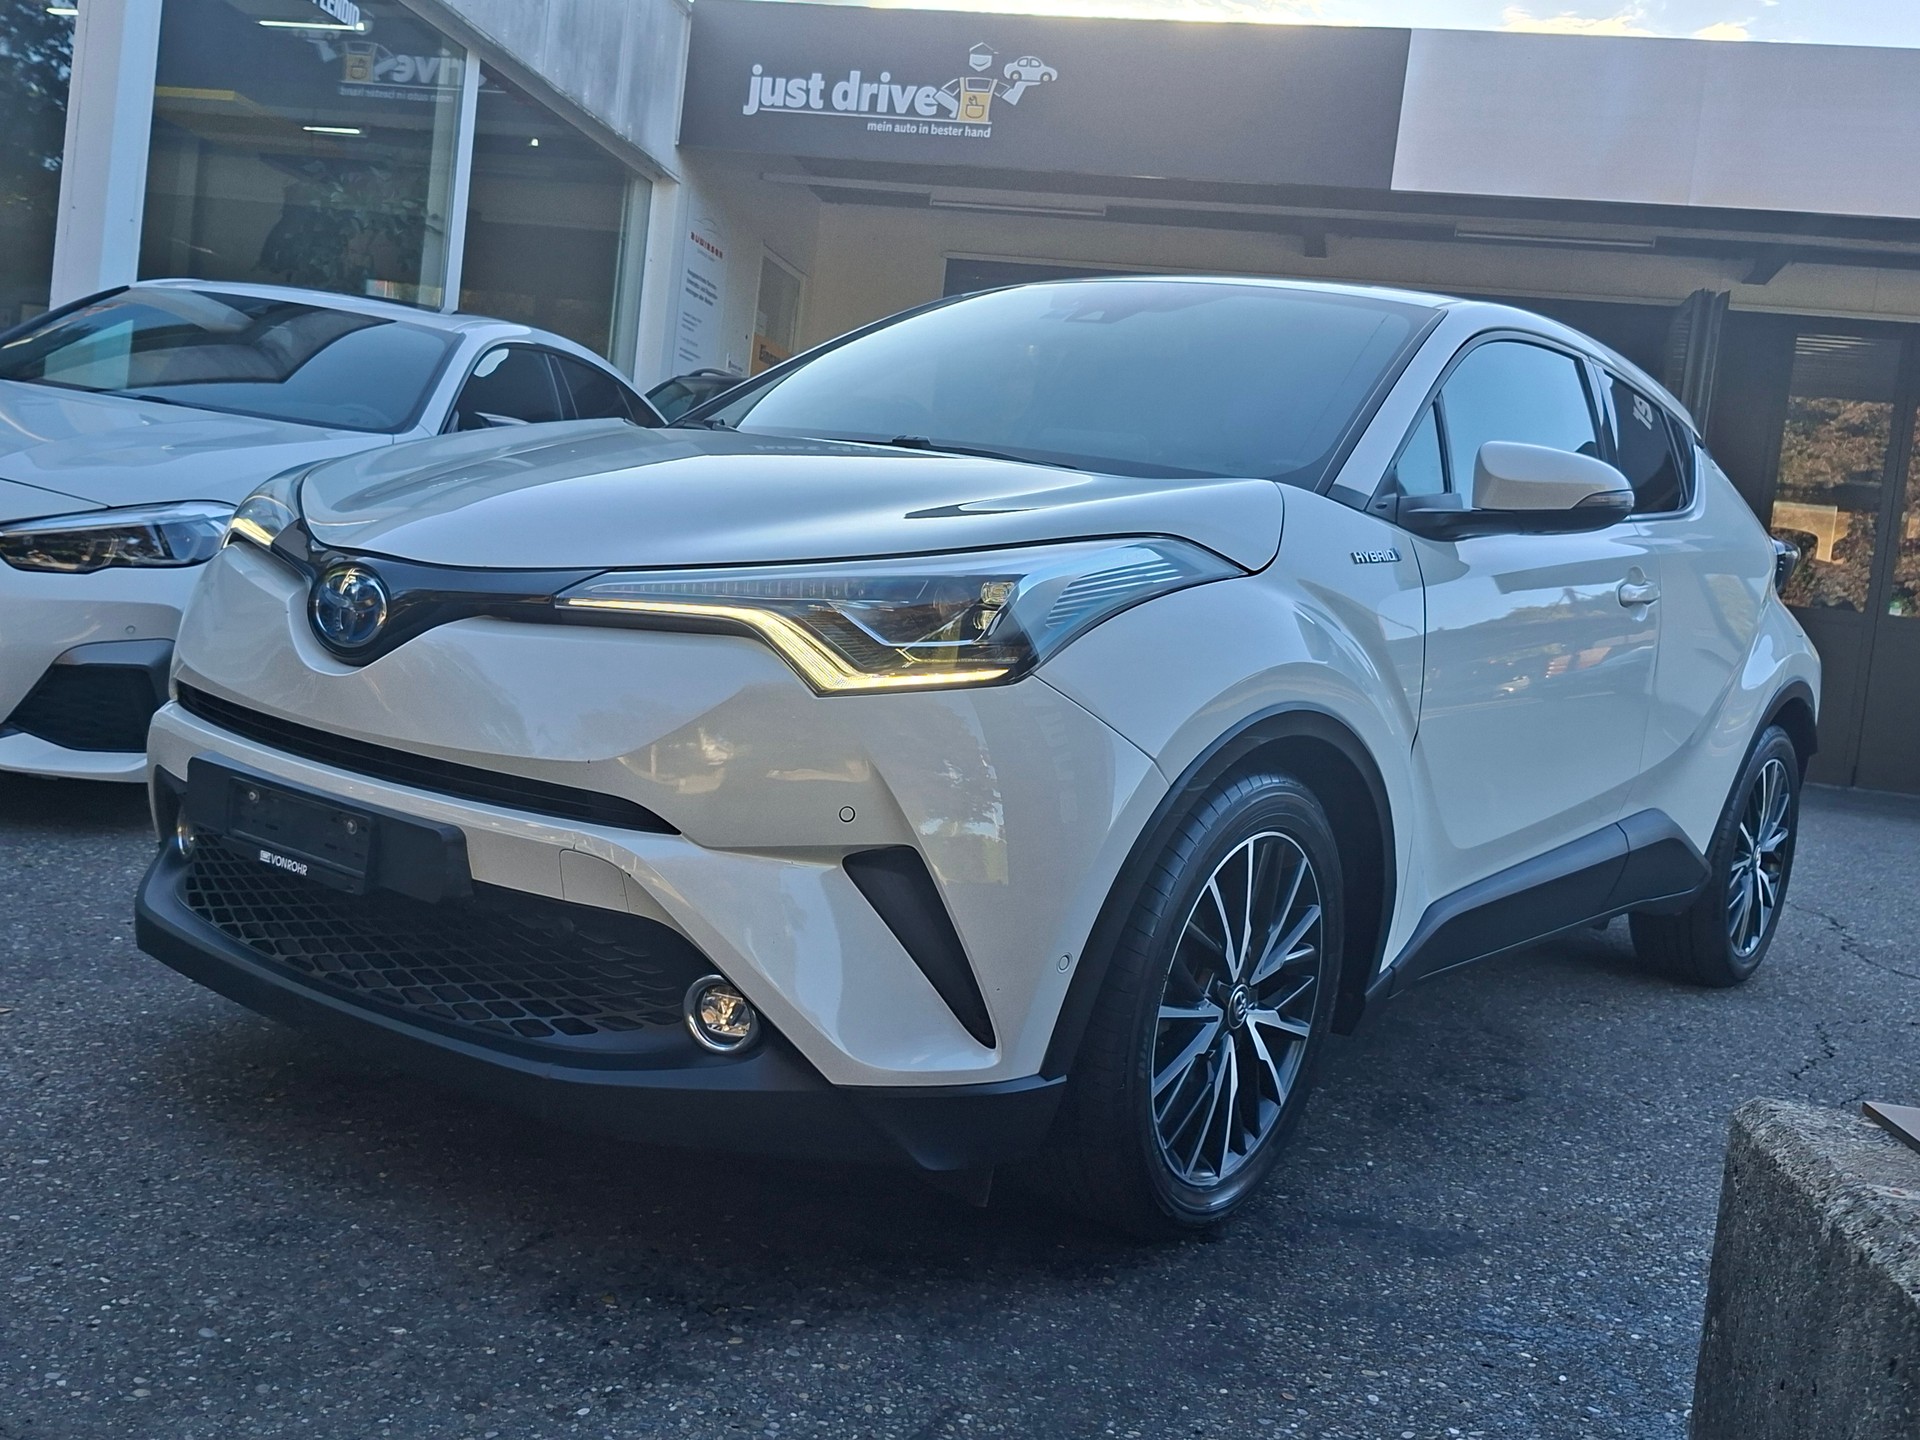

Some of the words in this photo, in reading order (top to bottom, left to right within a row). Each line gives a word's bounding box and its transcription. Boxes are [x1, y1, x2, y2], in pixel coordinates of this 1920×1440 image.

[742, 64, 825, 115] just
[831, 70, 938, 116] drive
[867, 121, 893, 132] mein
[894, 123, 917, 134] auto
[918, 121, 929, 134] in
[930, 124, 963, 137] bester
[964, 126, 991, 138] hand
[1353, 550, 1396, 563] HYBRID
